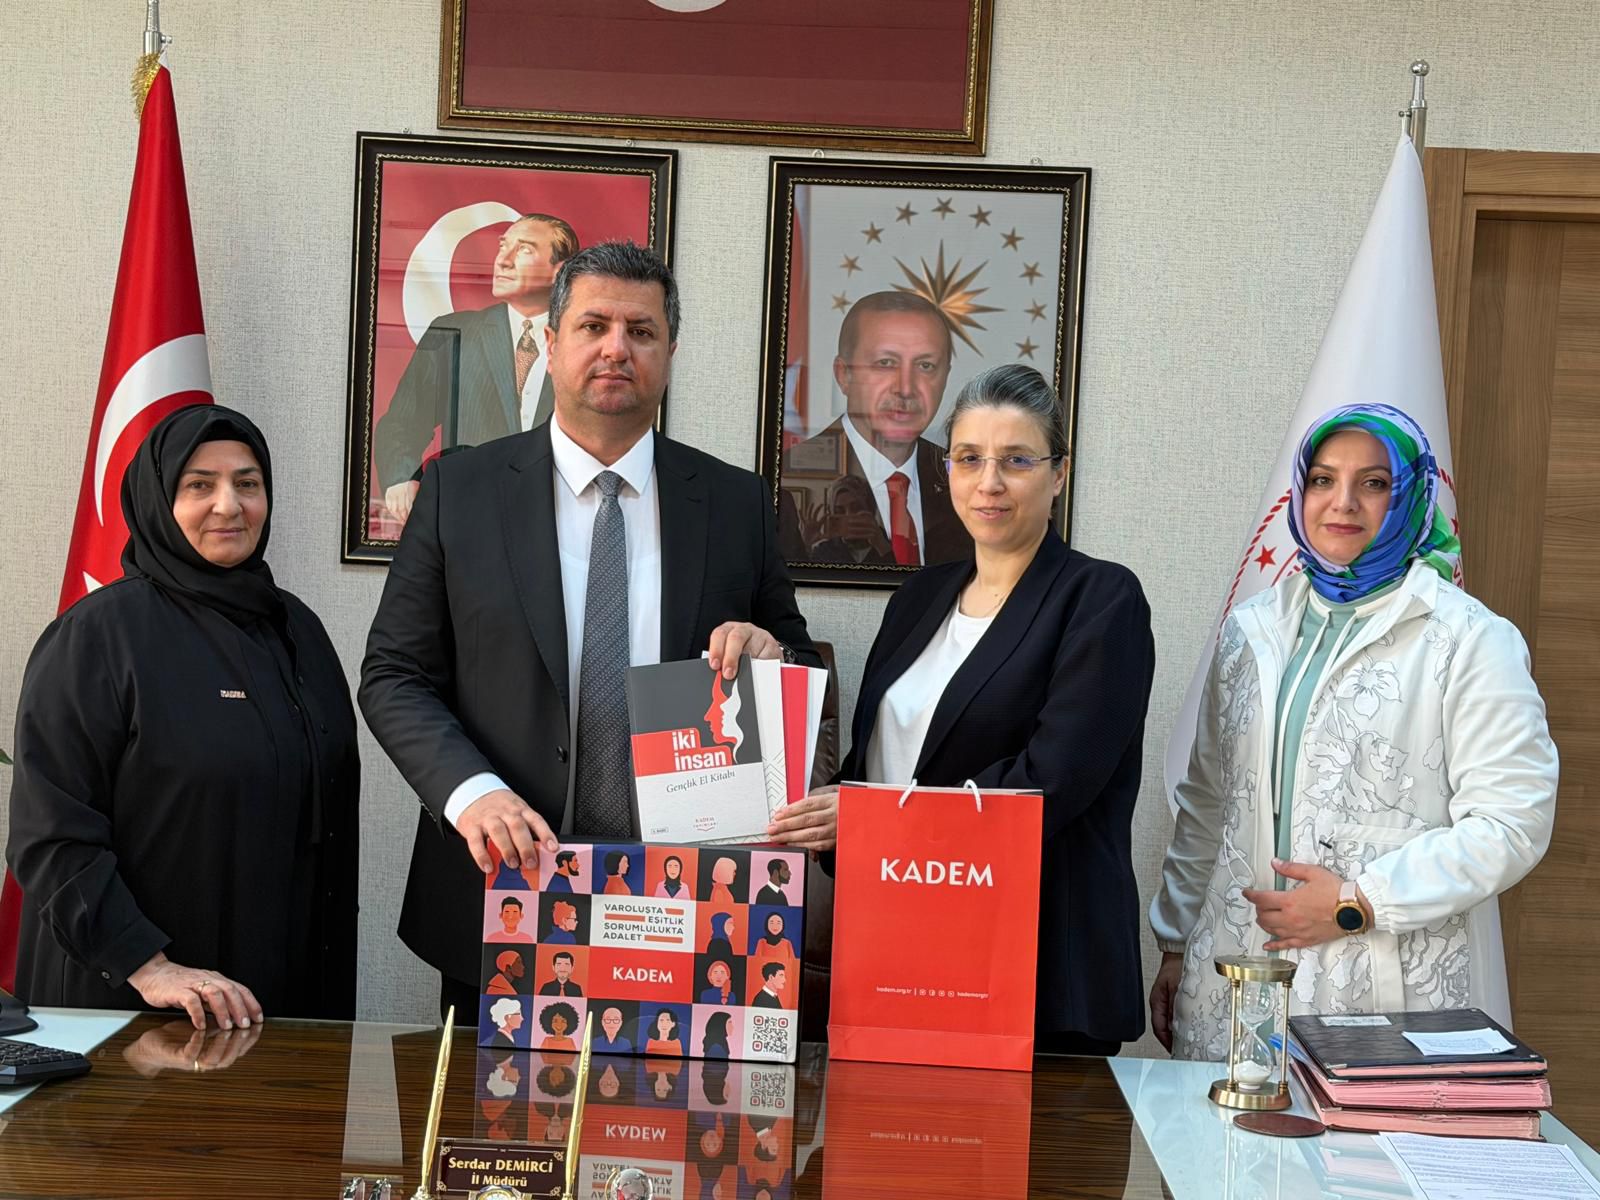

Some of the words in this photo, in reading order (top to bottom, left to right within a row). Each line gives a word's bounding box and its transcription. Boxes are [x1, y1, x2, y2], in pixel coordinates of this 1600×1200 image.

[672, 729, 696, 750] iki
[674, 751, 726, 771] insan
[666, 778, 697, 793] Gençlik
[699, 775, 708, 785] El
[710, 769, 735, 783] Kitabı
[880, 857, 993, 887] KADEM
[603, 932, 642, 941] ADALET
[604, 922, 684, 935] SORUMLULUKTA
[612, 966, 673, 984] KADEM
[448, 1157, 491, 1170] Serdar
[495, 1158, 553, 1173] DEMİRCİ
[471, 1172, 480, 1185] İl
[482, 1175, 528, 1187] Müdürü
